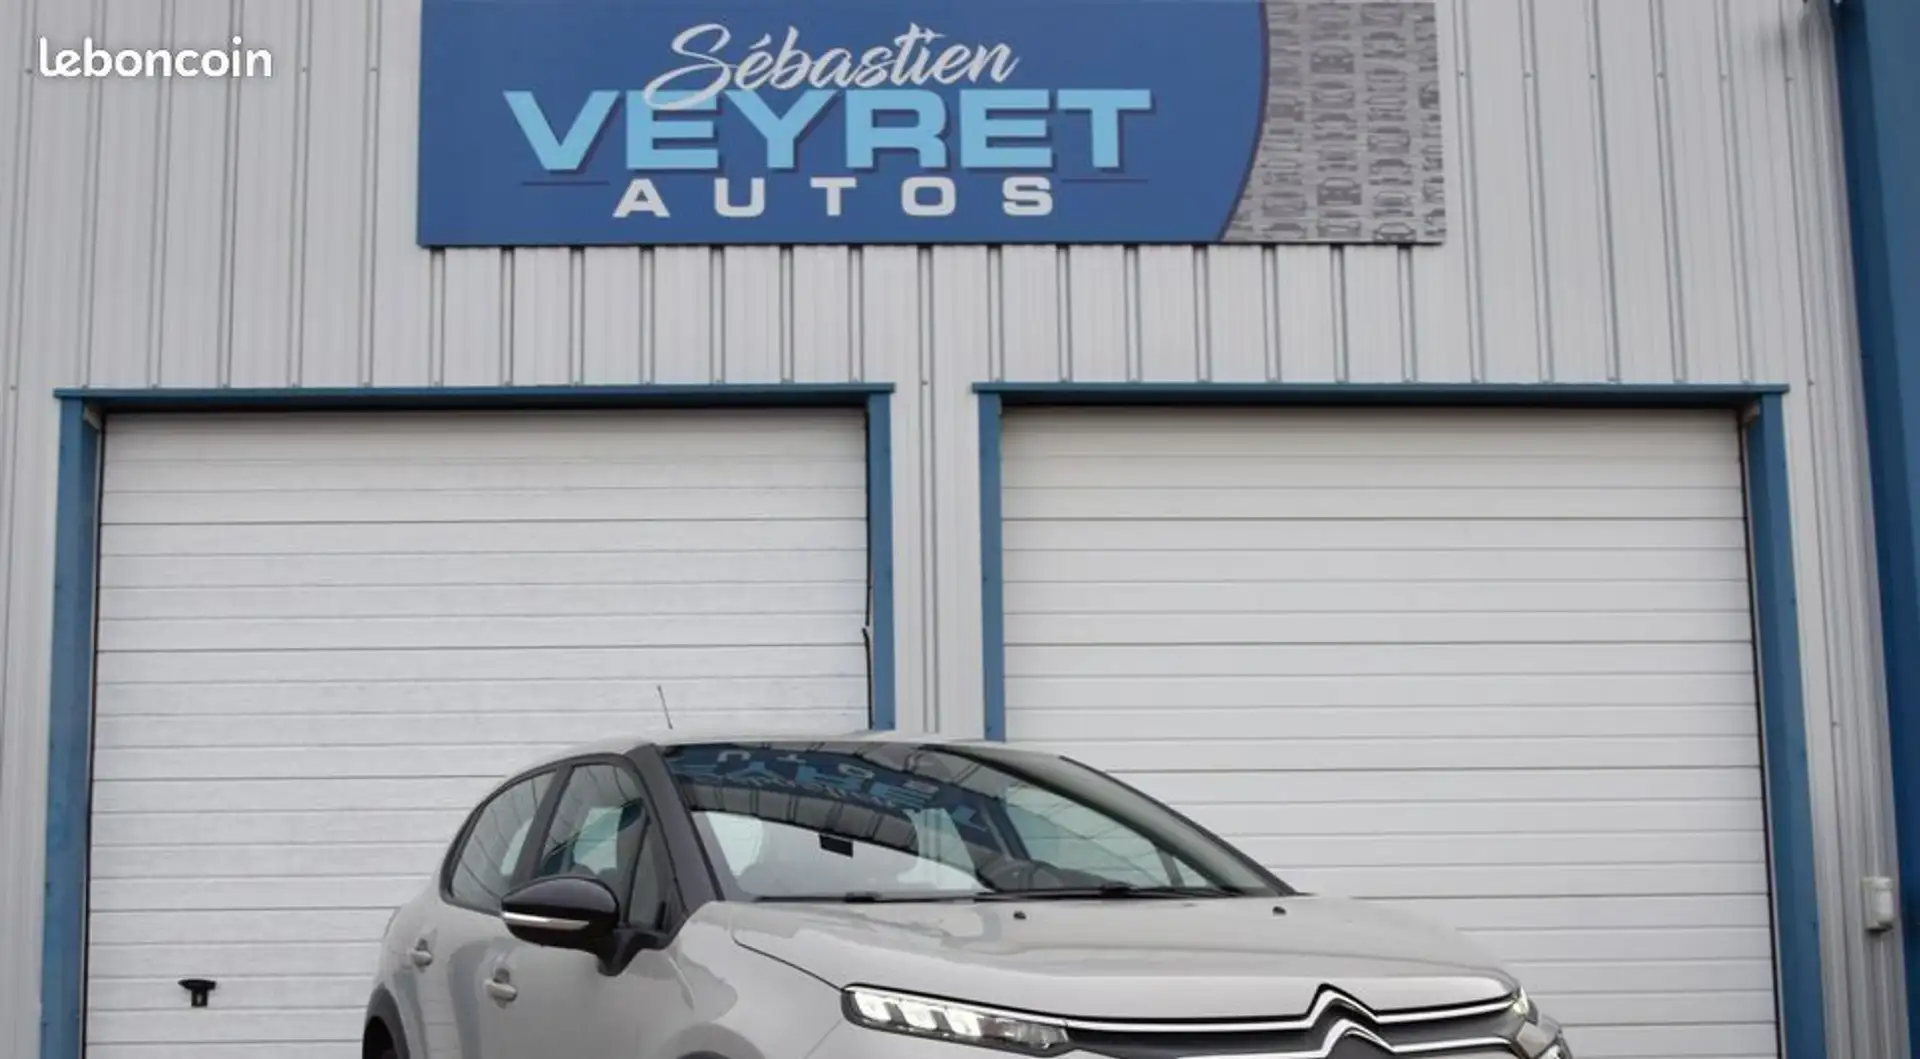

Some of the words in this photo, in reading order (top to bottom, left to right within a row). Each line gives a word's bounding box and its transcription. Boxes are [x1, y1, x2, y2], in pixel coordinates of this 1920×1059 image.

[643, 23, 1020, 110] Sébastien
[503, 89, 1153, 171] VEYRET
[612, 177, 1053, 217] AUTOS
